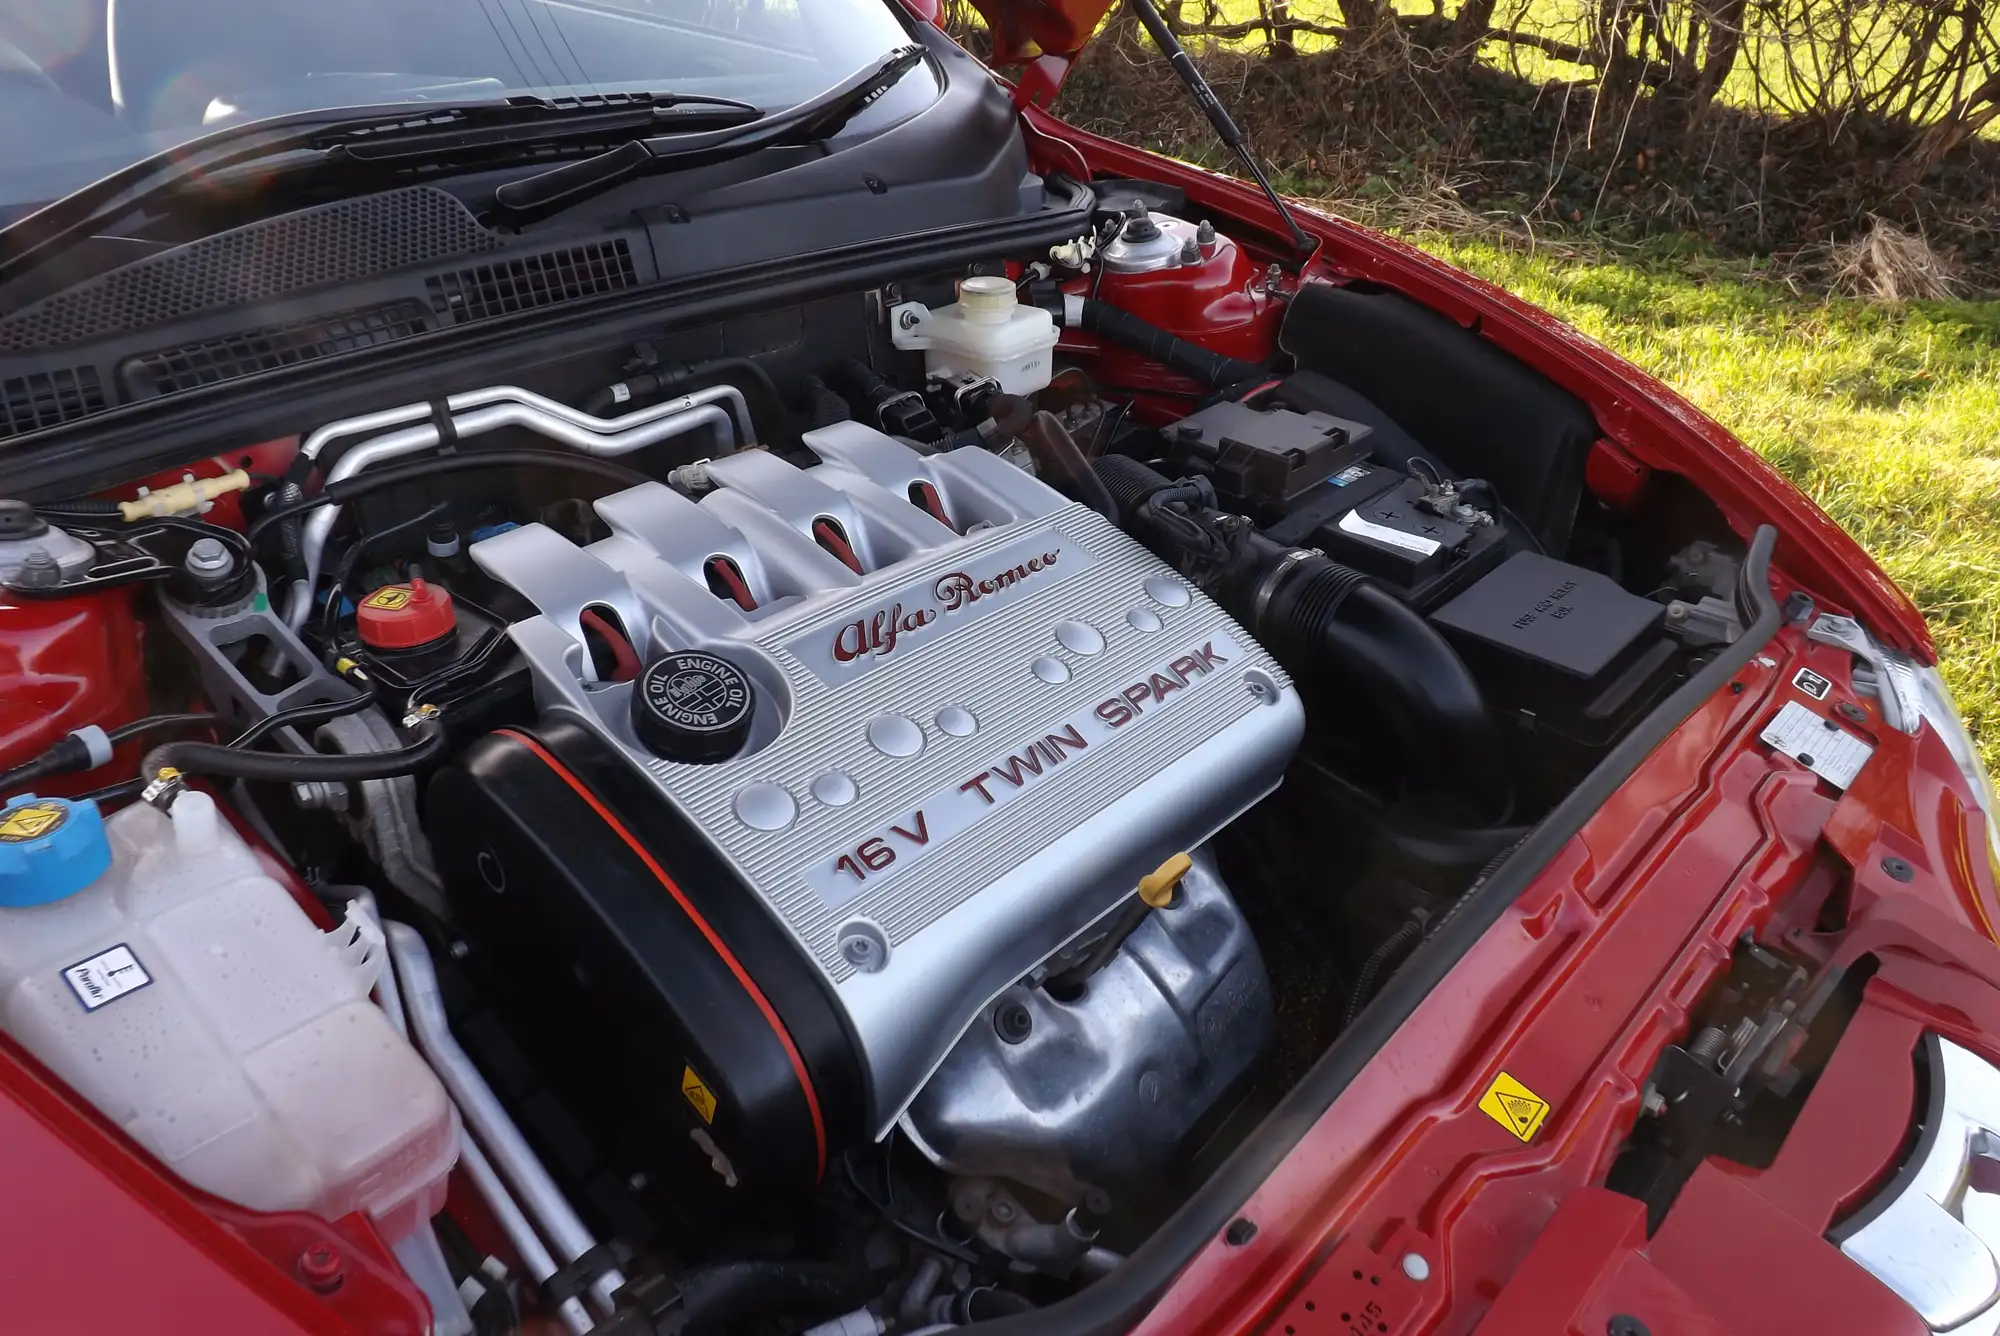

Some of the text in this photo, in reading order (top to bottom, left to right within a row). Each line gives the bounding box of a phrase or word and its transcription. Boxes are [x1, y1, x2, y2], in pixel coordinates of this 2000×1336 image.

[833, 549, 1061, 662] Alfa Romeo
[1512, 611, 1537, 629] FUSE
[1550, 605, 1574, 619] BOX
[650, 674, 718, 725] ENGINE OIL
[676, 658, 744, 708] ENGINE OIL
[959, 724, 1089, 804] TWIN
[1096, 641, 1229, 729] SPARK
